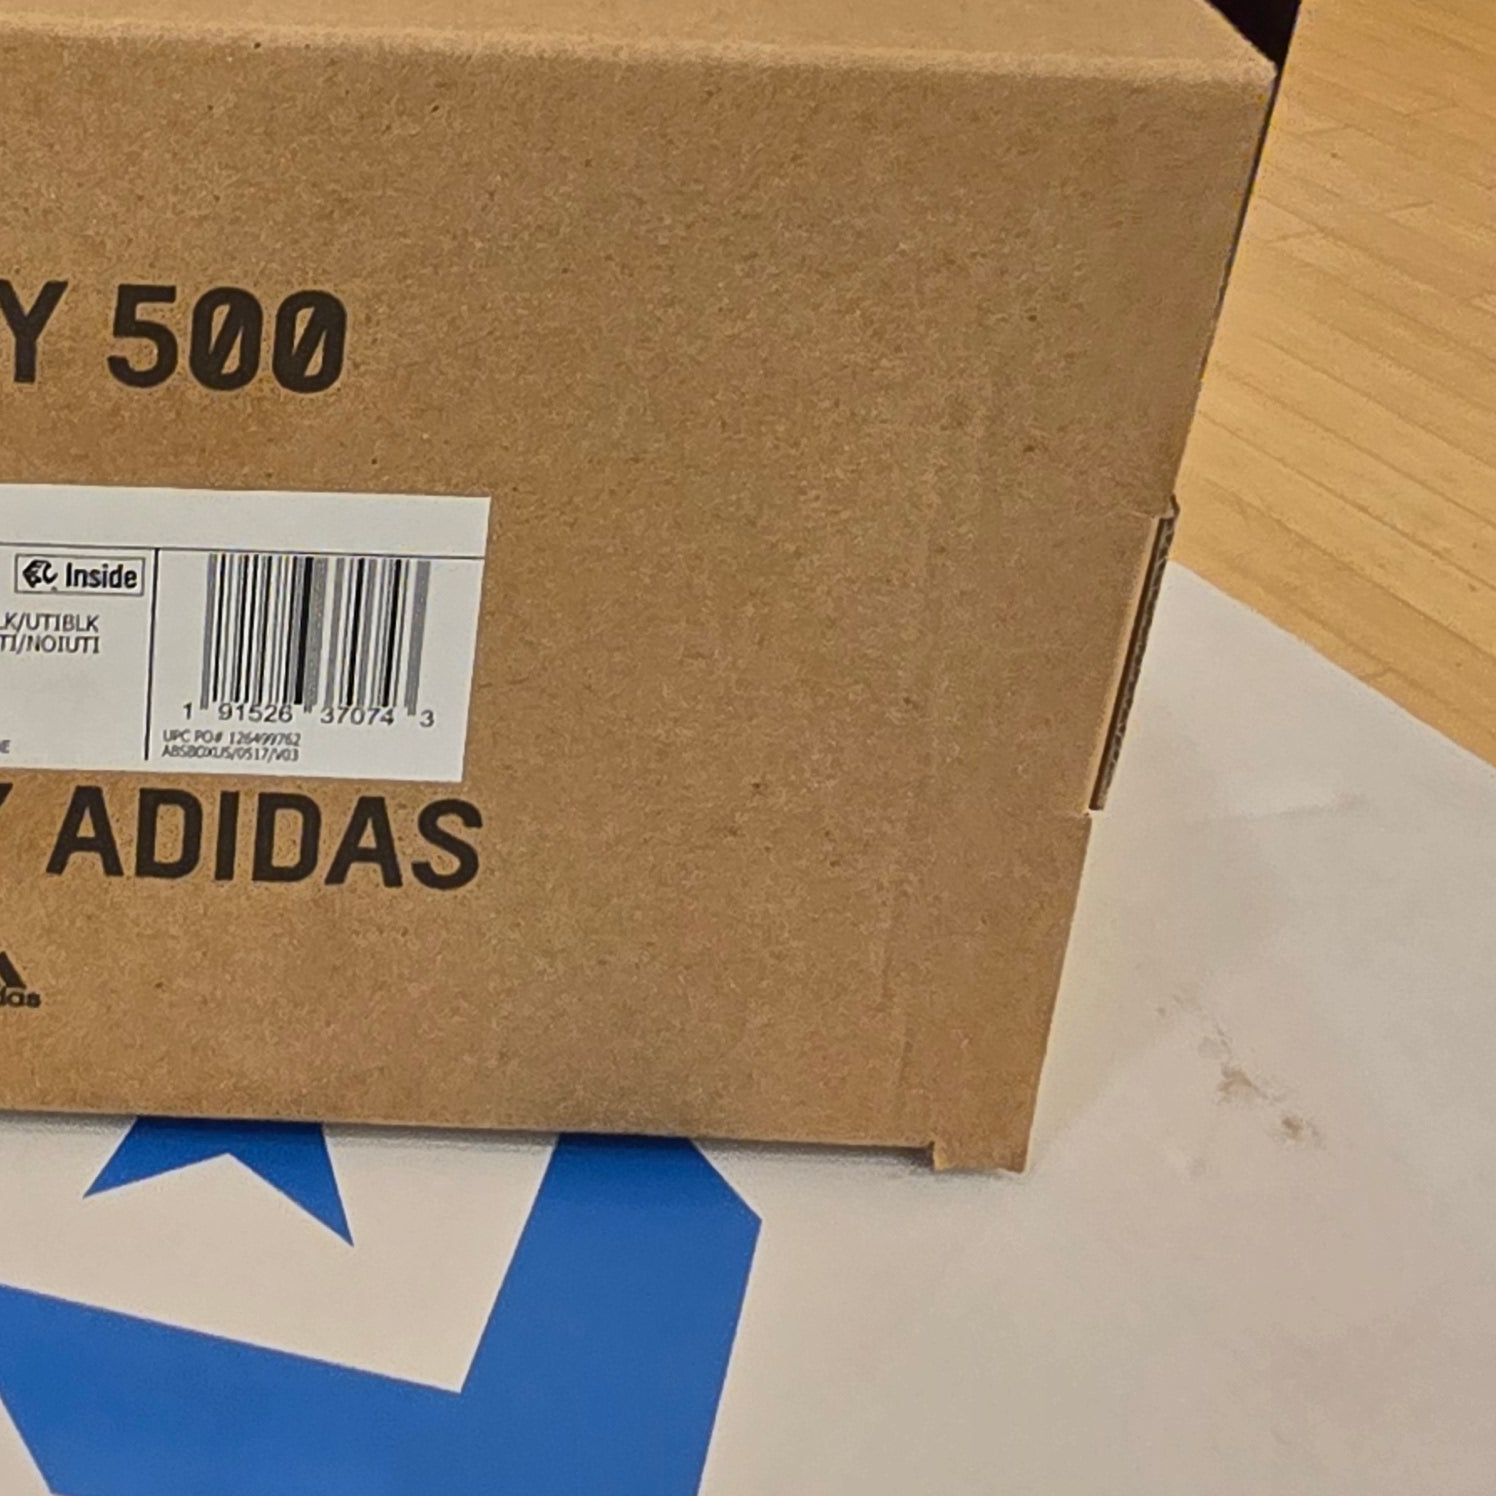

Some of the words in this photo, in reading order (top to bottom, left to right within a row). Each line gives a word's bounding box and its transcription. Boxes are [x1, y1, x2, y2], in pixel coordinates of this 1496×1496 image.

[106, 282, 348, 394] 500
[65, 562, 138, 590] Inside
[218, 703, 293, 723] 91526
[320, 706, 394, 726] 37074
[163, 729, 191, 743] UPC
[44, 786, 483, 890] ADIDAS
